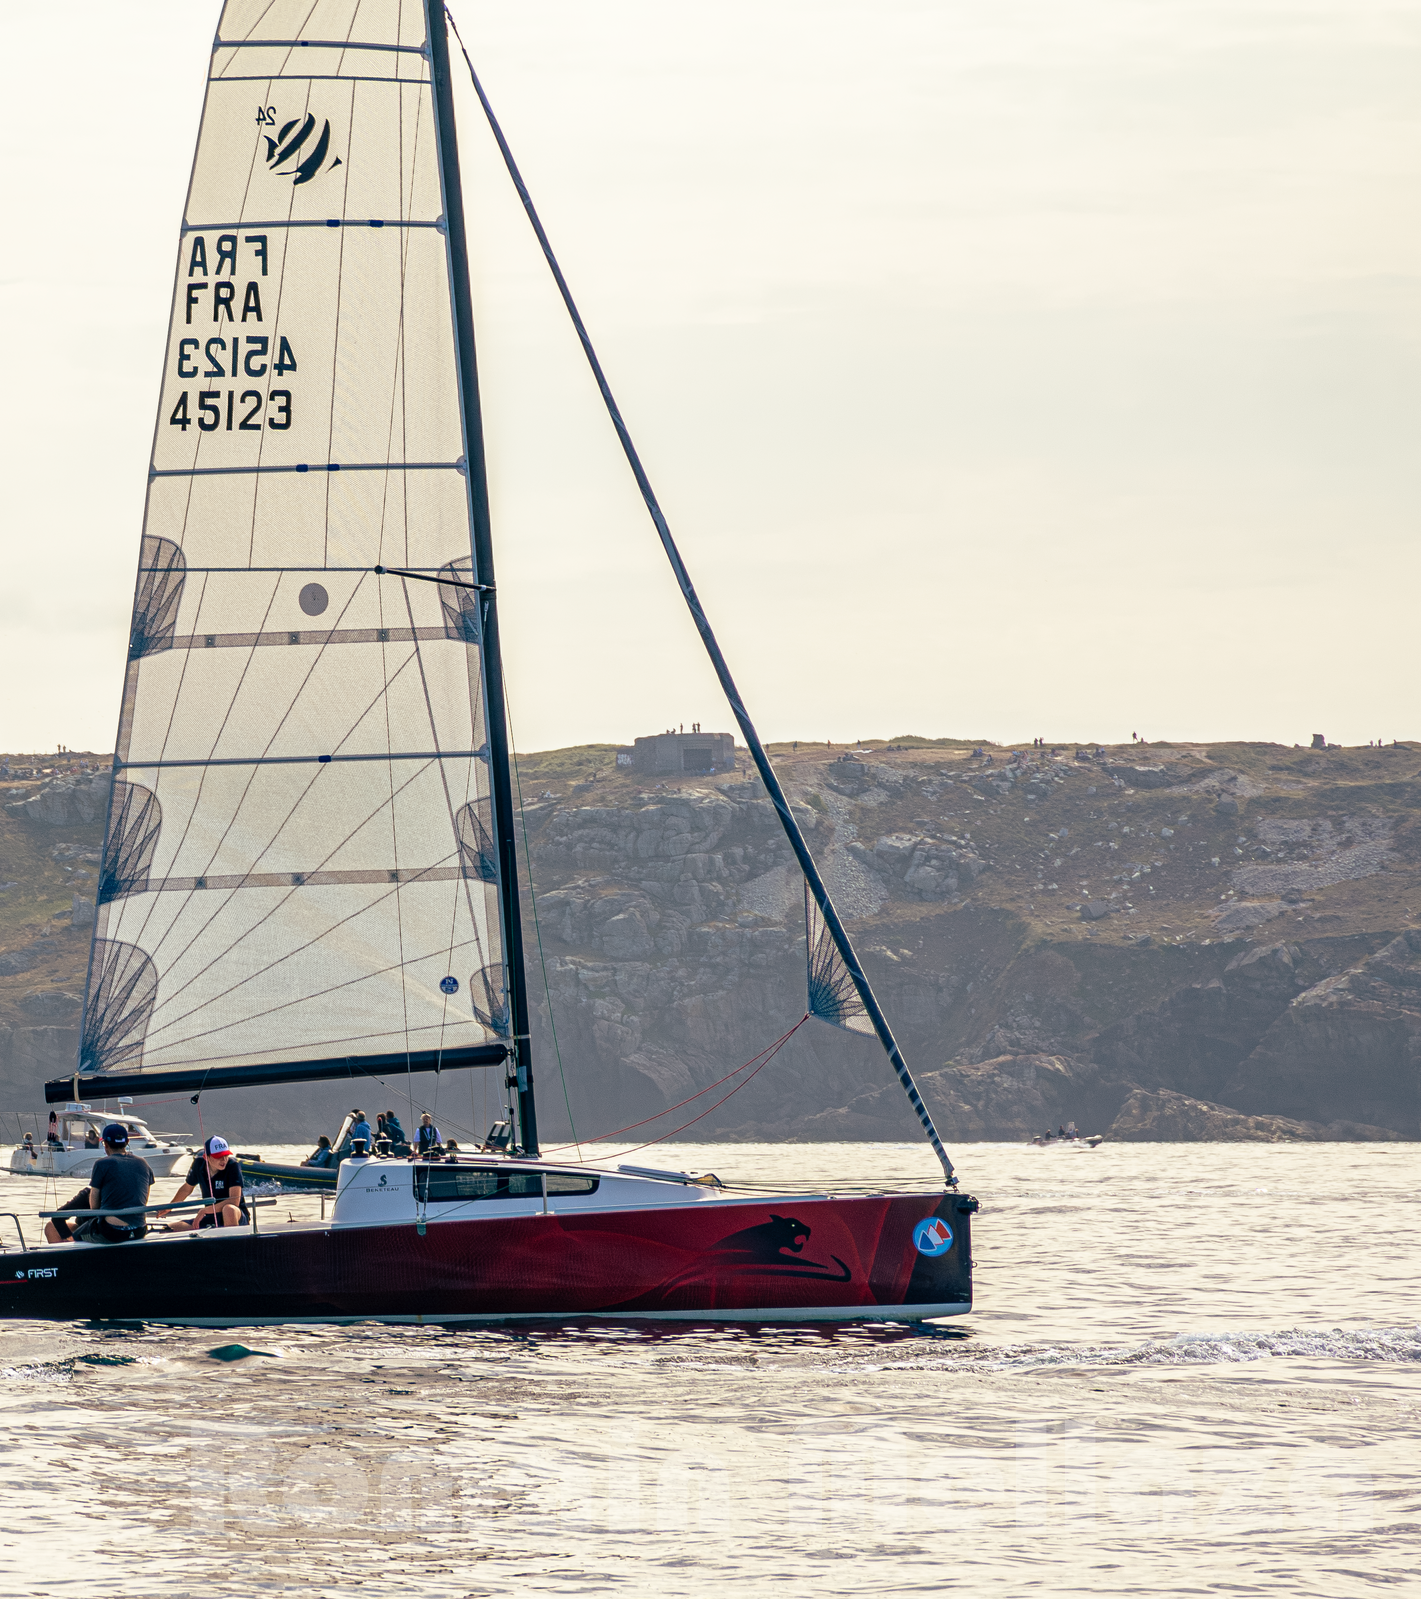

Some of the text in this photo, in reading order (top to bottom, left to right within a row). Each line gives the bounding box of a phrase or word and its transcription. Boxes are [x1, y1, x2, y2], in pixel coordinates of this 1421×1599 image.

[185, 281, 263, 324] FRA
[169, 389, 293, 431] 45123
[214, 1143, 228, 1151] FRA
[28, 1268, 58, 1278] FIRST
